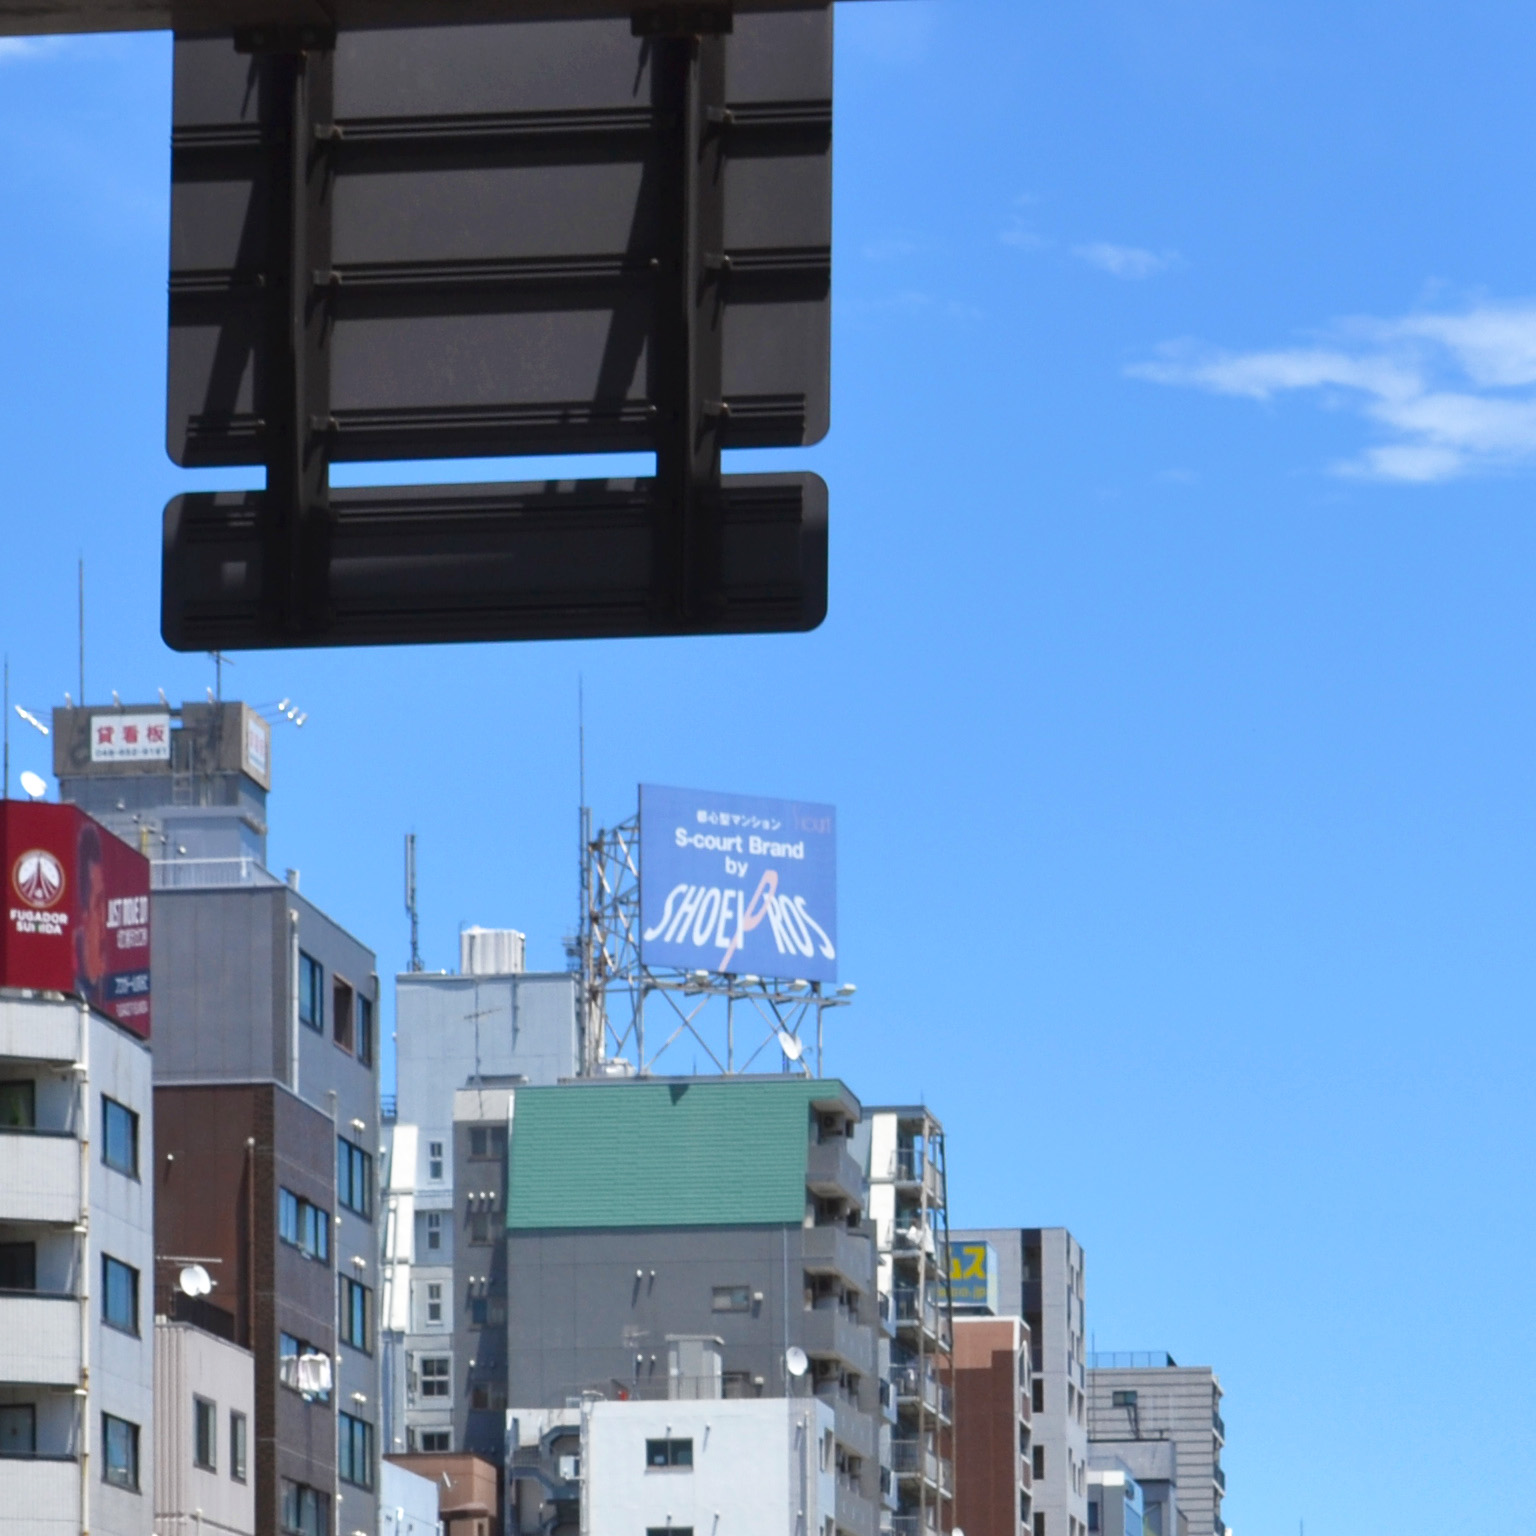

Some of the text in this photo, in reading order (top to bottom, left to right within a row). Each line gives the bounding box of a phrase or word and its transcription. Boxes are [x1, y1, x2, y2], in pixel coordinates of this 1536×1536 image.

[96, 724, 165, 745] 貸看板
[675, 827, 805, 860] S-court Brand
[724, 855, 749, 878] by
[9, 907, 68, 926] FUGADOR
